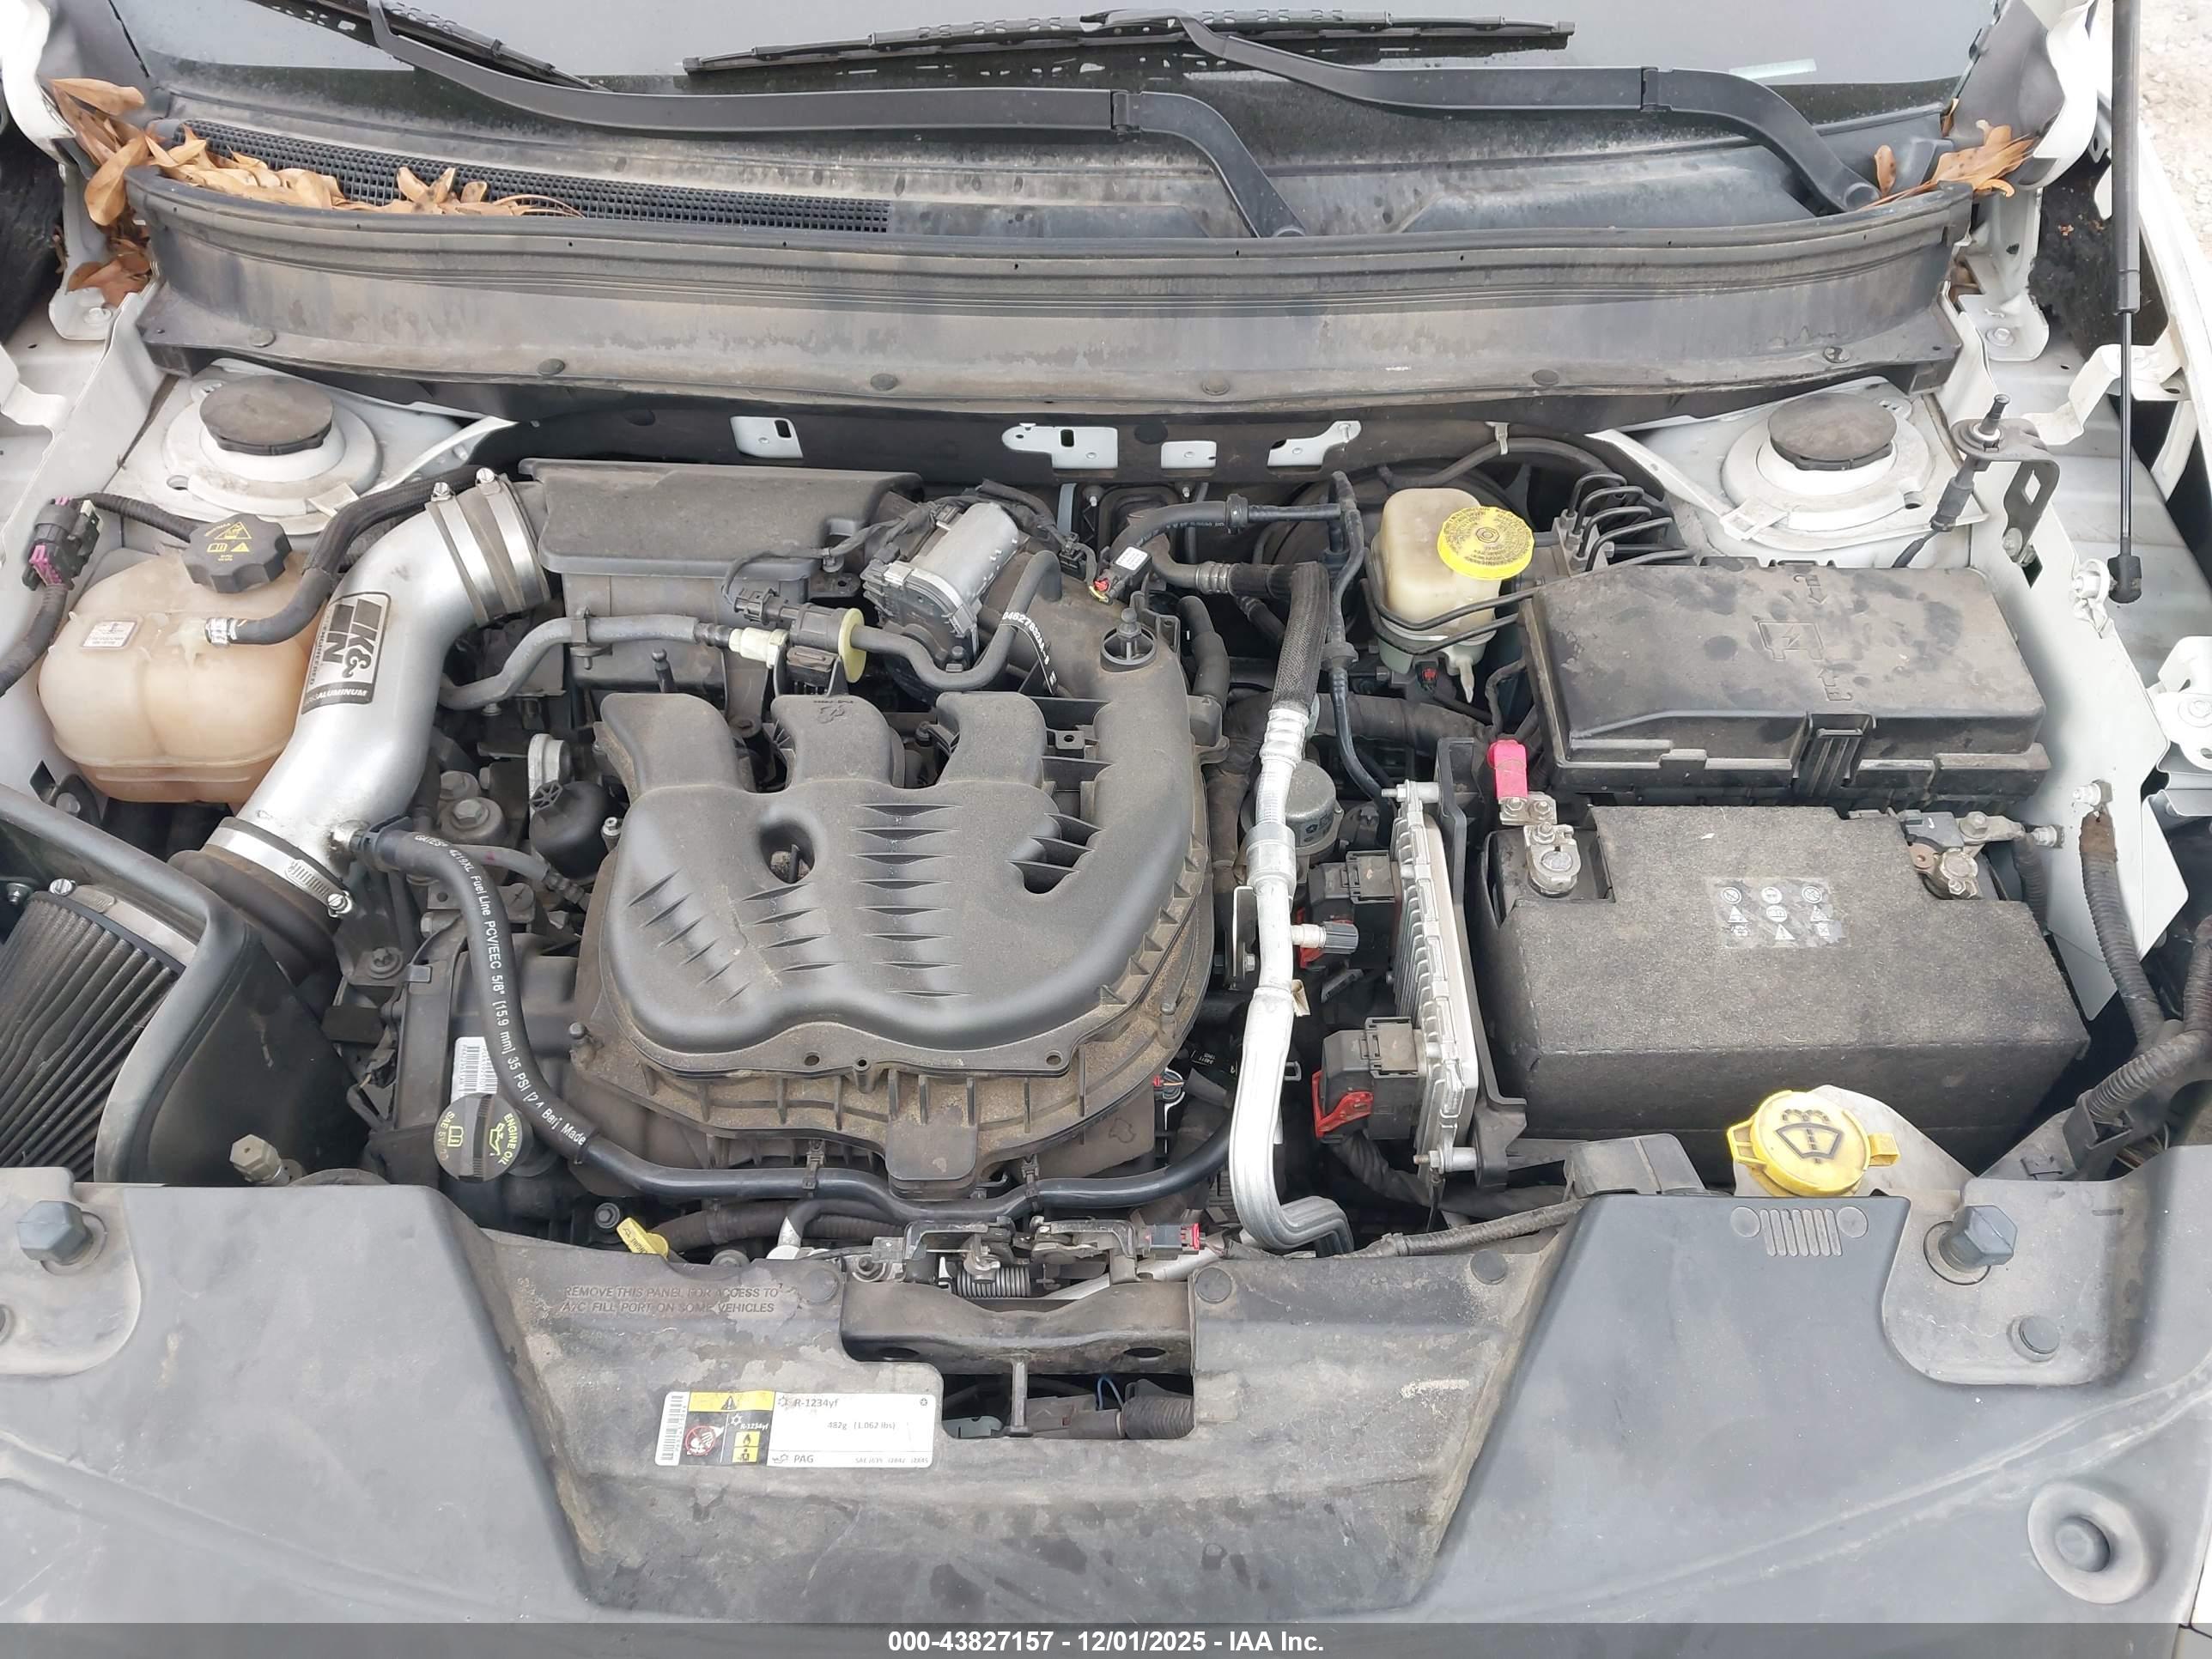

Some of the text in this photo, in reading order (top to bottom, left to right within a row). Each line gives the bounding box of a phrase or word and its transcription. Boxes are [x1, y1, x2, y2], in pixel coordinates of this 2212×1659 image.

[470, 874, 486, 896] Fuel
[477, 895, 492, 916] Line
[483, 920, 502, 969] PCV/EEC
[507, 1056, 522, 1071] 35
[514, 1073, 532, 1092] PSI
[439, 1110, 456, 1132] SAE
[497, 1112, 519, 1166] ENGINE OIL
[561, 1122, 587, 1146] Made
[563, 1286, 779, 1298] REMOVE THIS PANEL FOR ACCESS TO
[563, 1301, 775, 1313] A/C FILL PORT ON SOME VEHICLES
[793, 1398, 839, 1409] R-1234yf
[793, 1454, 815, 1464] PAG
